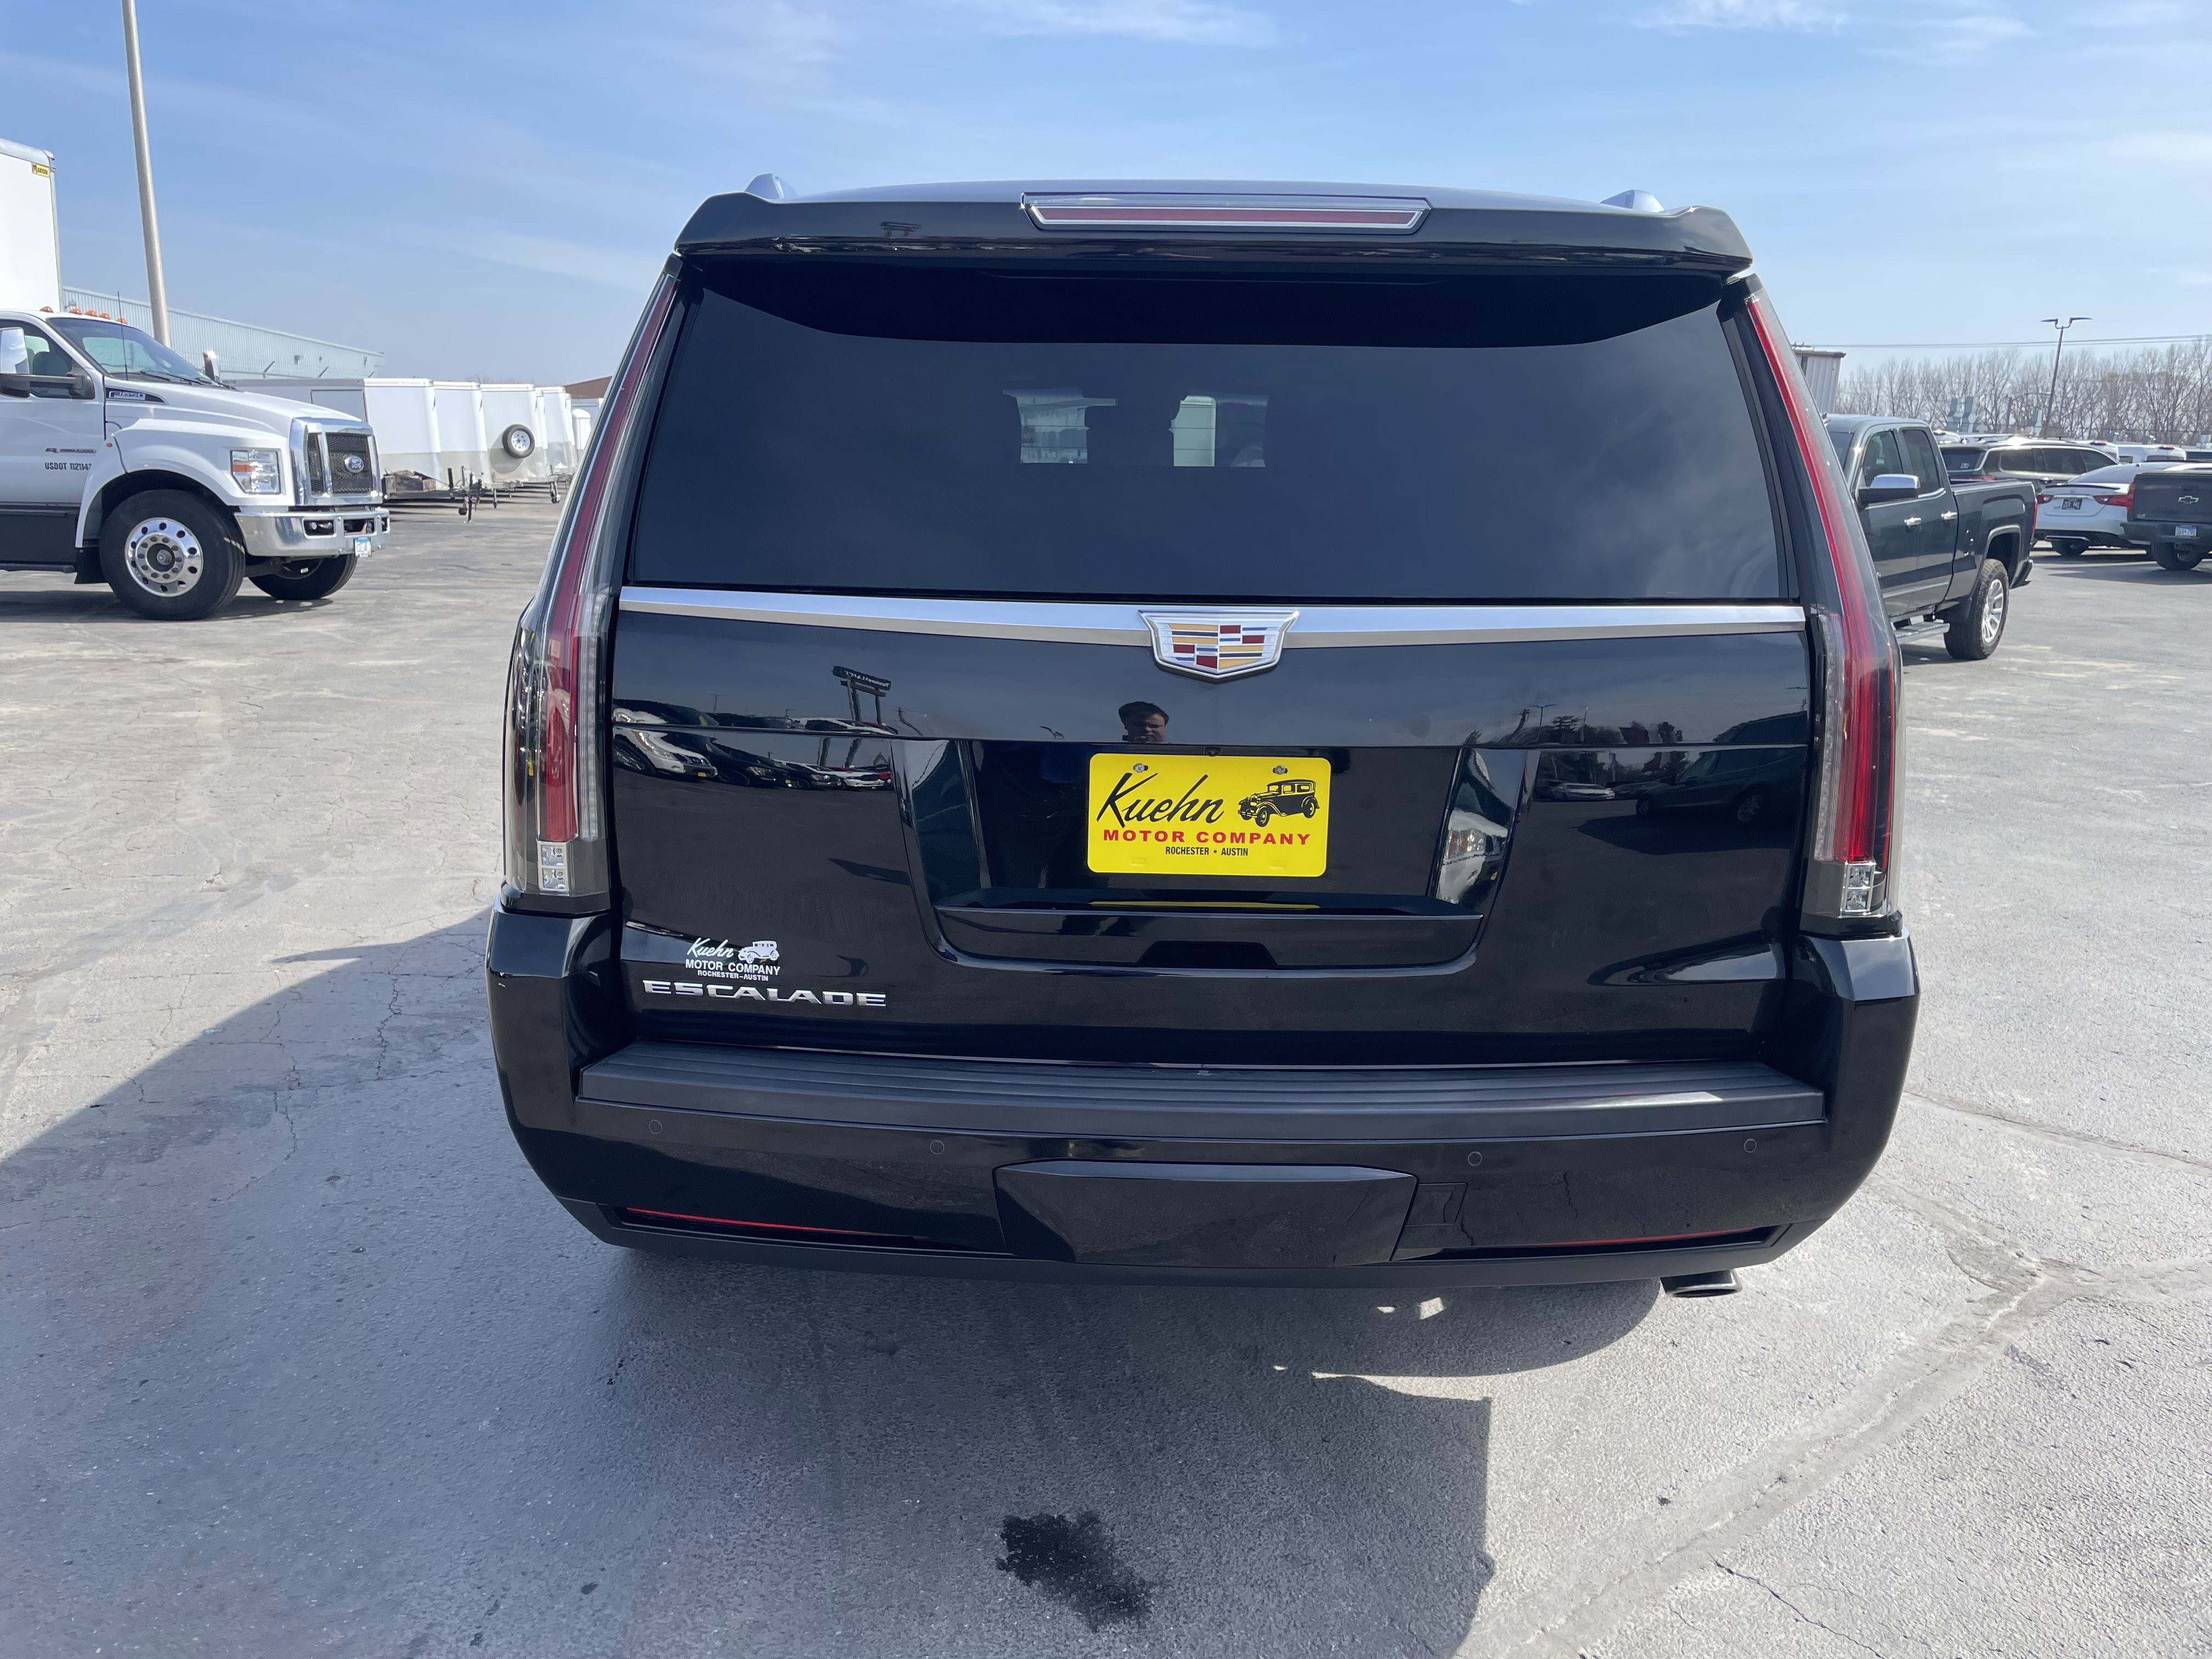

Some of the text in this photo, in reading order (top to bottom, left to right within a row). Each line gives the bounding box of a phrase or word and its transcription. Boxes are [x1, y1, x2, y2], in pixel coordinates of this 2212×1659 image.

[1096, 772, 1224, 828] Kuehn
[1103, 829, 1311, 845] MOTOR COMPANY
[1165, 846, 1249, 856] ROCHESTER AUSTIN
[686, 937, 735, 958] Kuehn
[685, 958, 781, 976] MOTOR COMPANY
[642, 979, 887, 1007] ESCALADE
